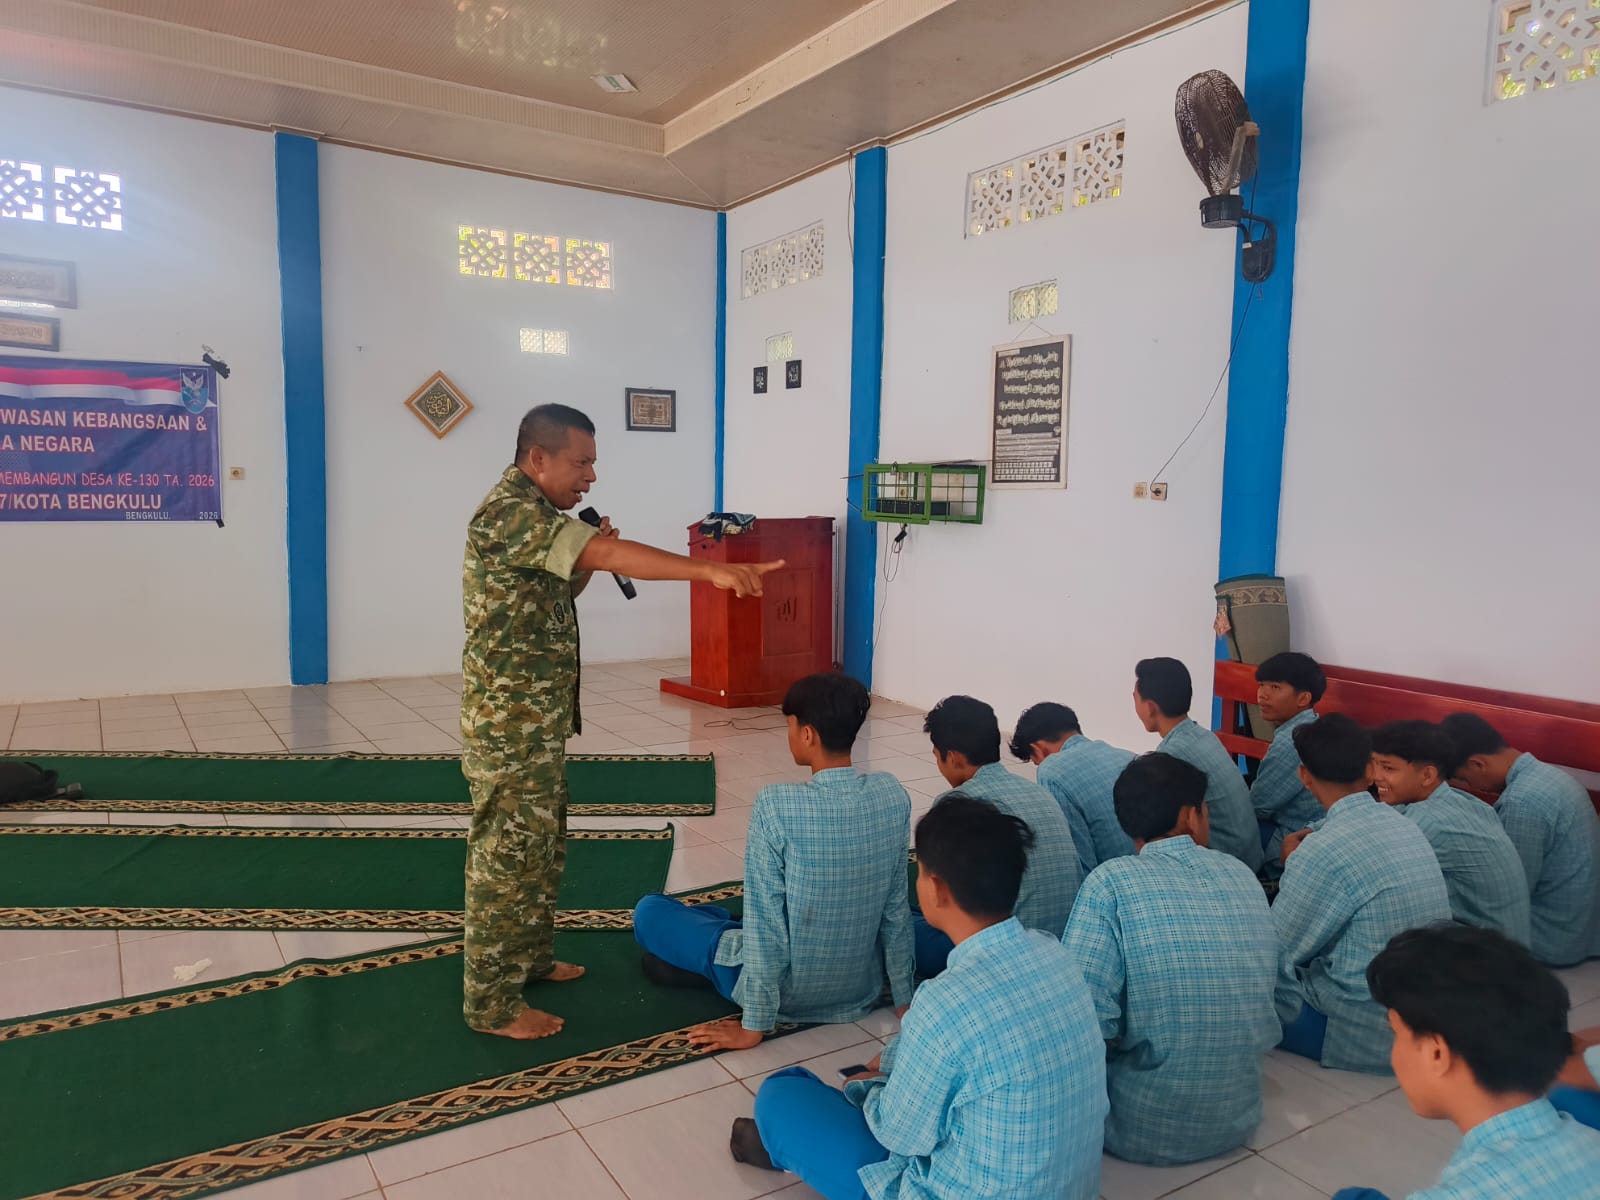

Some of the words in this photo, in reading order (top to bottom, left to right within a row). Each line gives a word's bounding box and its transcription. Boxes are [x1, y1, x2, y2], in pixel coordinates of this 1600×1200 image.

[73, 411, 190, 430] KEBANGSAAN
[196, 416, 207, 431] &
[20, 435, 95, 452] NEGARA
[81, 472, 113, 486] DESA
[118, 473, 160, 487] KE-130
[188, 474, 215, 487] 2026
[67, 494, 162, 510] BENGKULU
